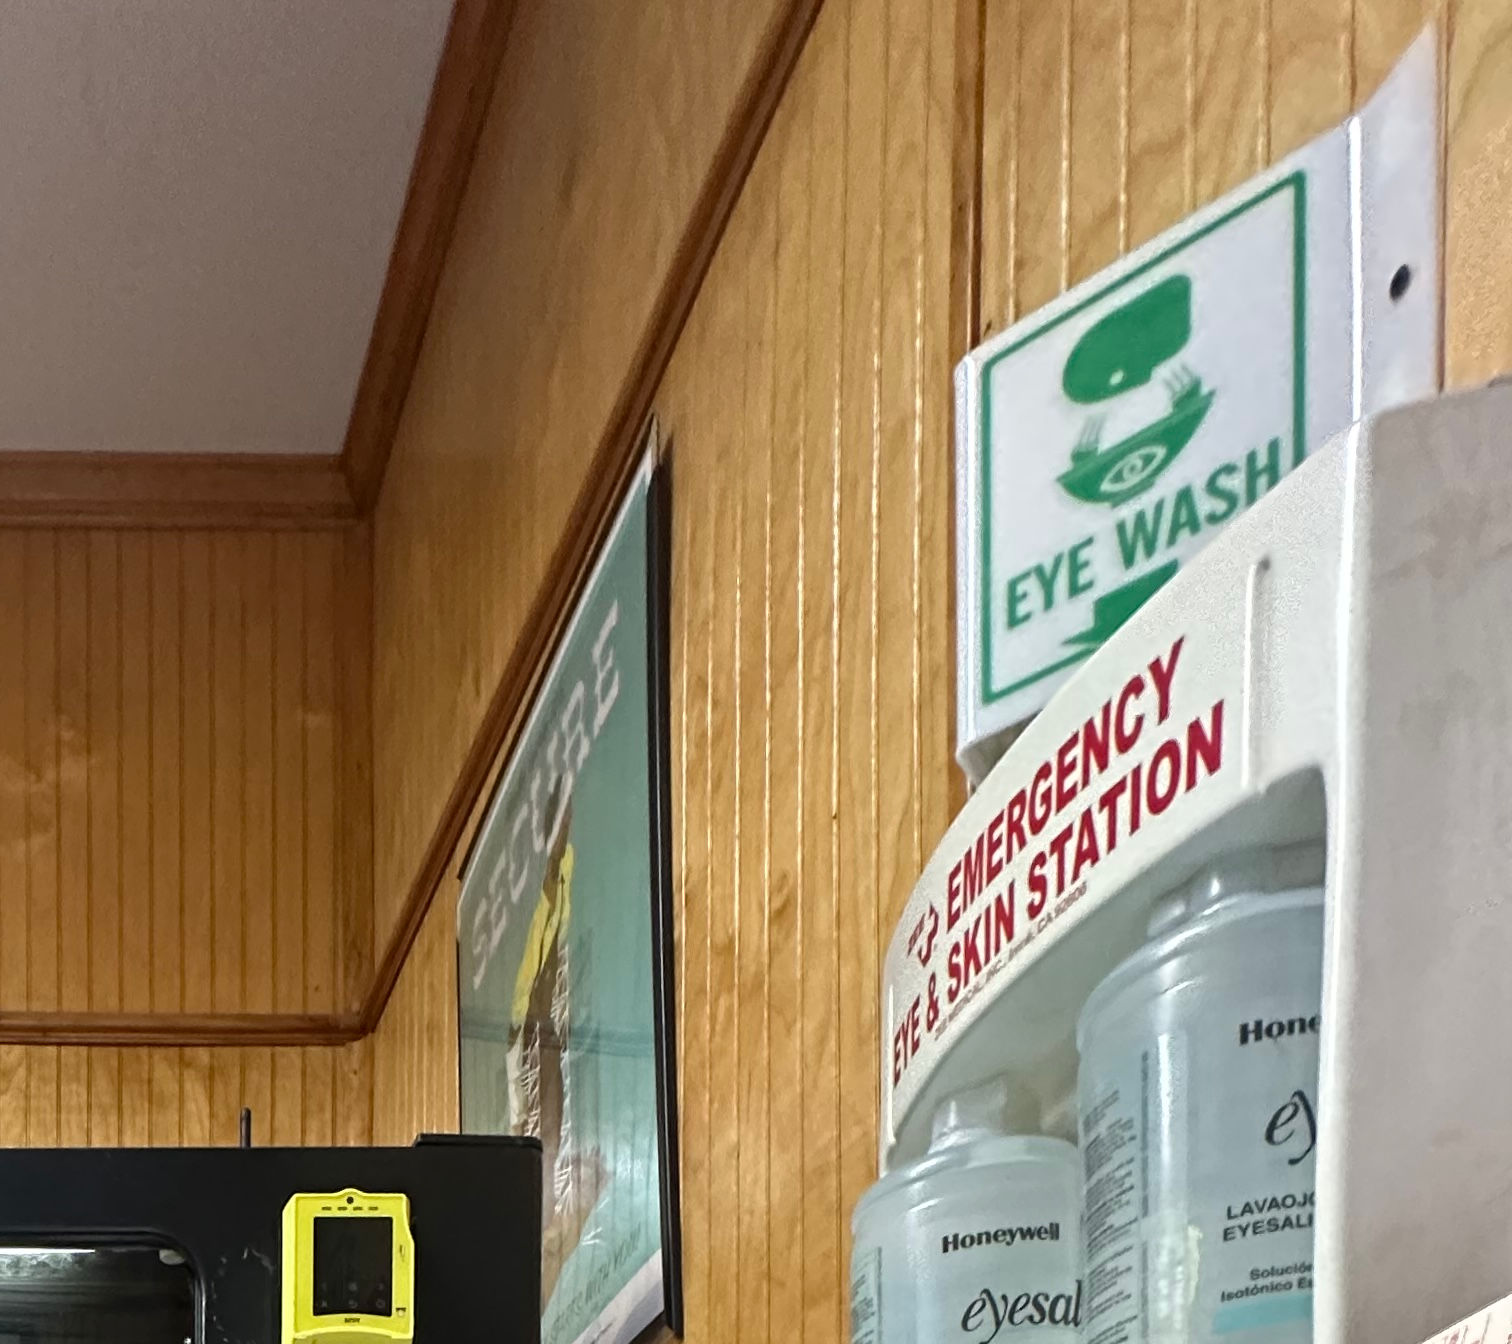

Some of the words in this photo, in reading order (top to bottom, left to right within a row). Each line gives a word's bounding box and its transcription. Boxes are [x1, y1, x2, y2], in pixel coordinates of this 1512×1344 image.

[1008, 537, 1094, 630] EYE
[1116, 437, 1281, 570] WASH
[894, 994, 921, 1089] EYE
[926, 972, 939, 1034] &
[947, 880, 1015, 1003] SKIN
[1026, 699, 1224, 920] STATION
[947, 635, 1185, 933] EMERGENCY
[942, 1222, 1060, 1253] Honeywell
